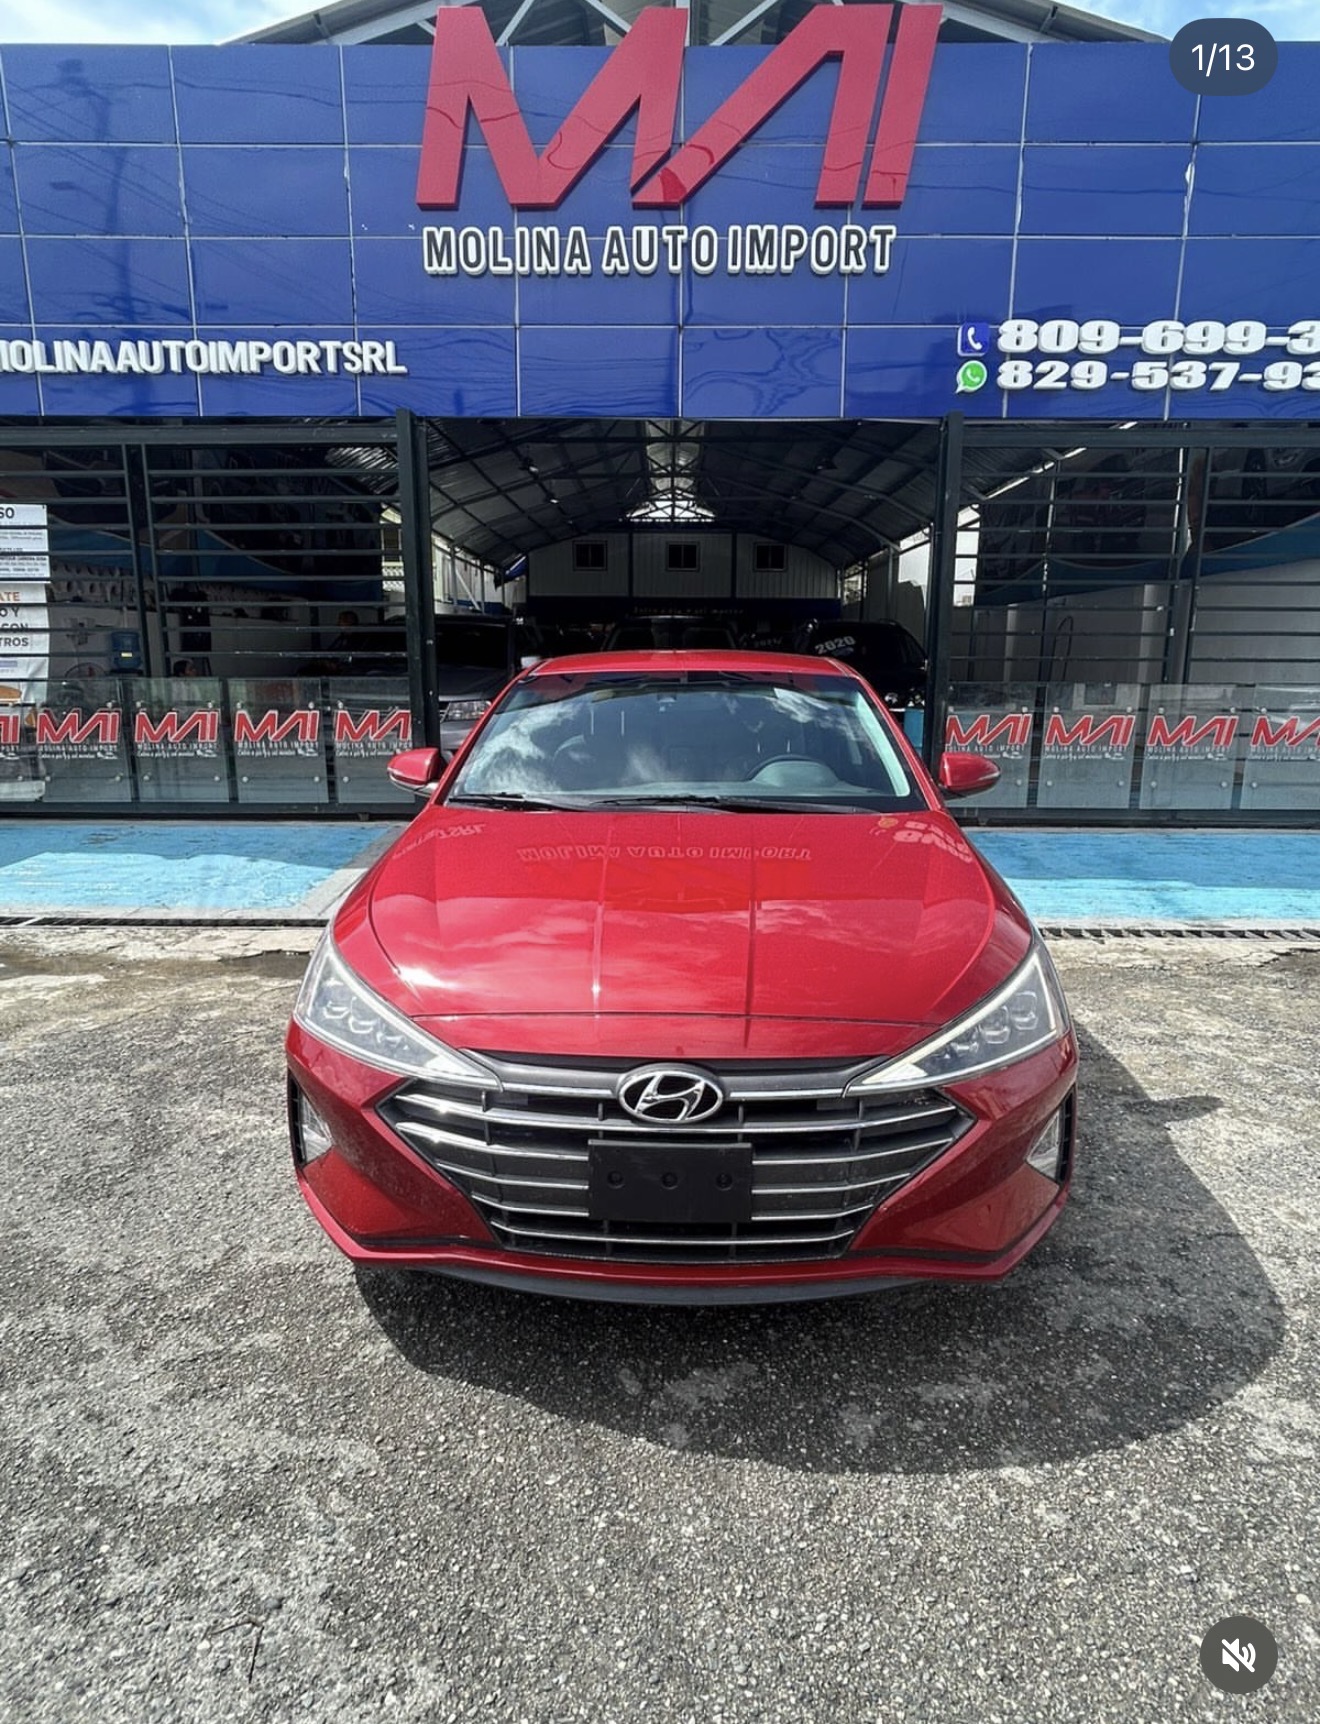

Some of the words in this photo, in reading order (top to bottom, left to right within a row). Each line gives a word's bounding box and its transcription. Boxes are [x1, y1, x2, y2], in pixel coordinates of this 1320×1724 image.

[415, 4, 943, 210] MAI
[422, 226, 592, 275] MOLINA
[602, 225, 719, 274] AUTO
[727, 224, 898, 274] IMPORT
[815, 636, 856, 655] 2020
